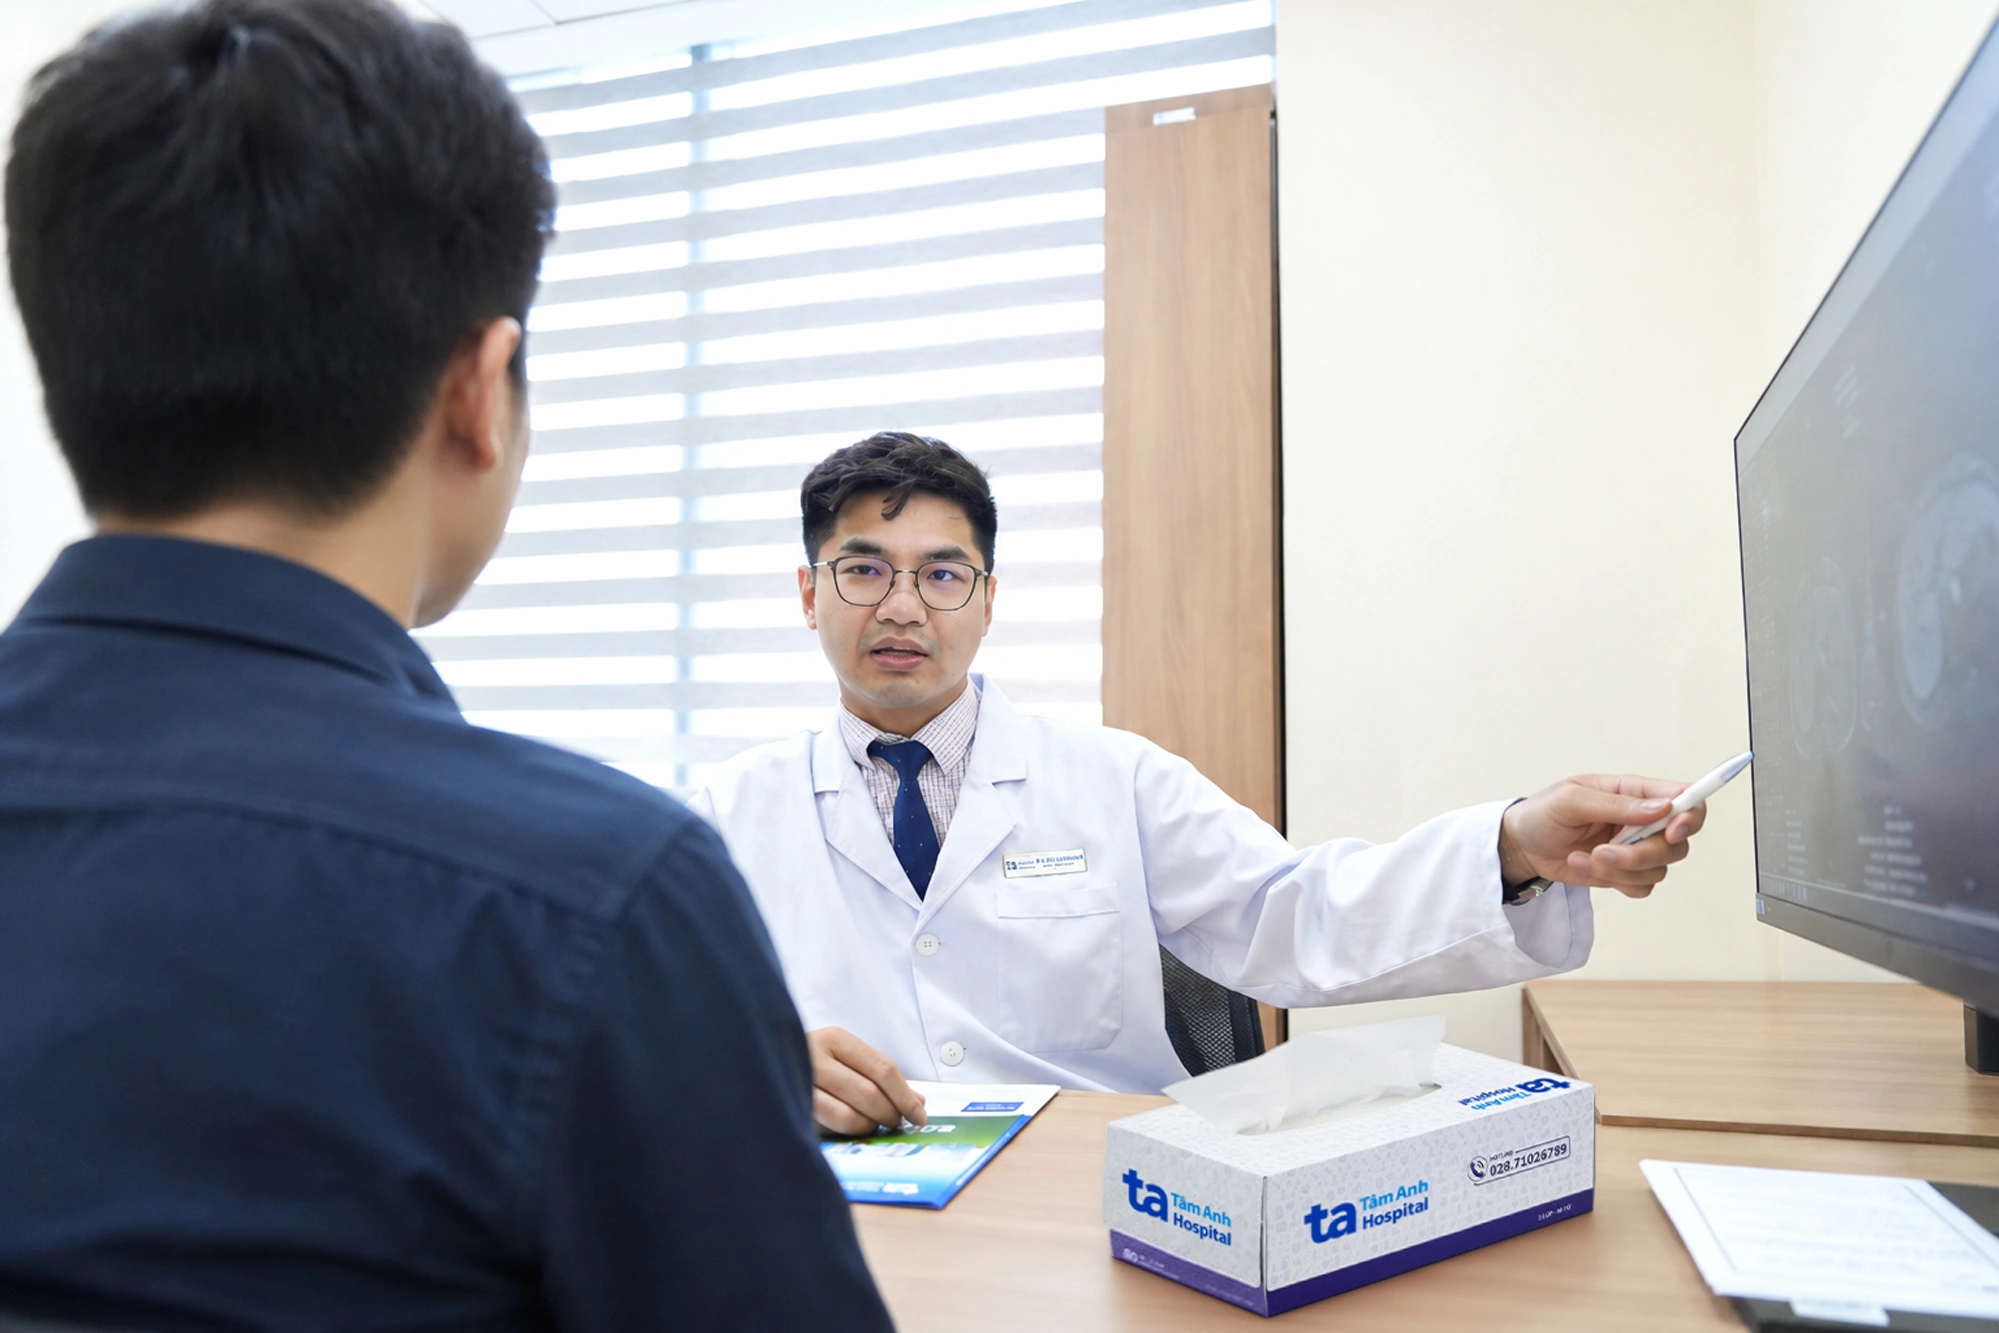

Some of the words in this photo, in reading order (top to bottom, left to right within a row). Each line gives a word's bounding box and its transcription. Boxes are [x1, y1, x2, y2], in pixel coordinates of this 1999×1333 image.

[1458, 1086, 1516, 1106] Hospital
[1515, 1078, 1570, 1093] ta
[1471, 1099, 1501, 1111] Anh
[1489, 1143, 1567, 1177] 028.71026789
[1122, 1168, 1168, 1222] ta
[1171, 1192, 1200, 1215] Tâm
[1202, 1205, 1232, 1227] Anh
[1360, 1192, 1393, 1211] Tâm
[1395, 1180, 1429, 1201] Anh
[1173, 1212, 1232, 1246] Hospital
[1304, 1203, 1357, 1244] ta
[1362, 1197, 1429, 1229] Hospital
